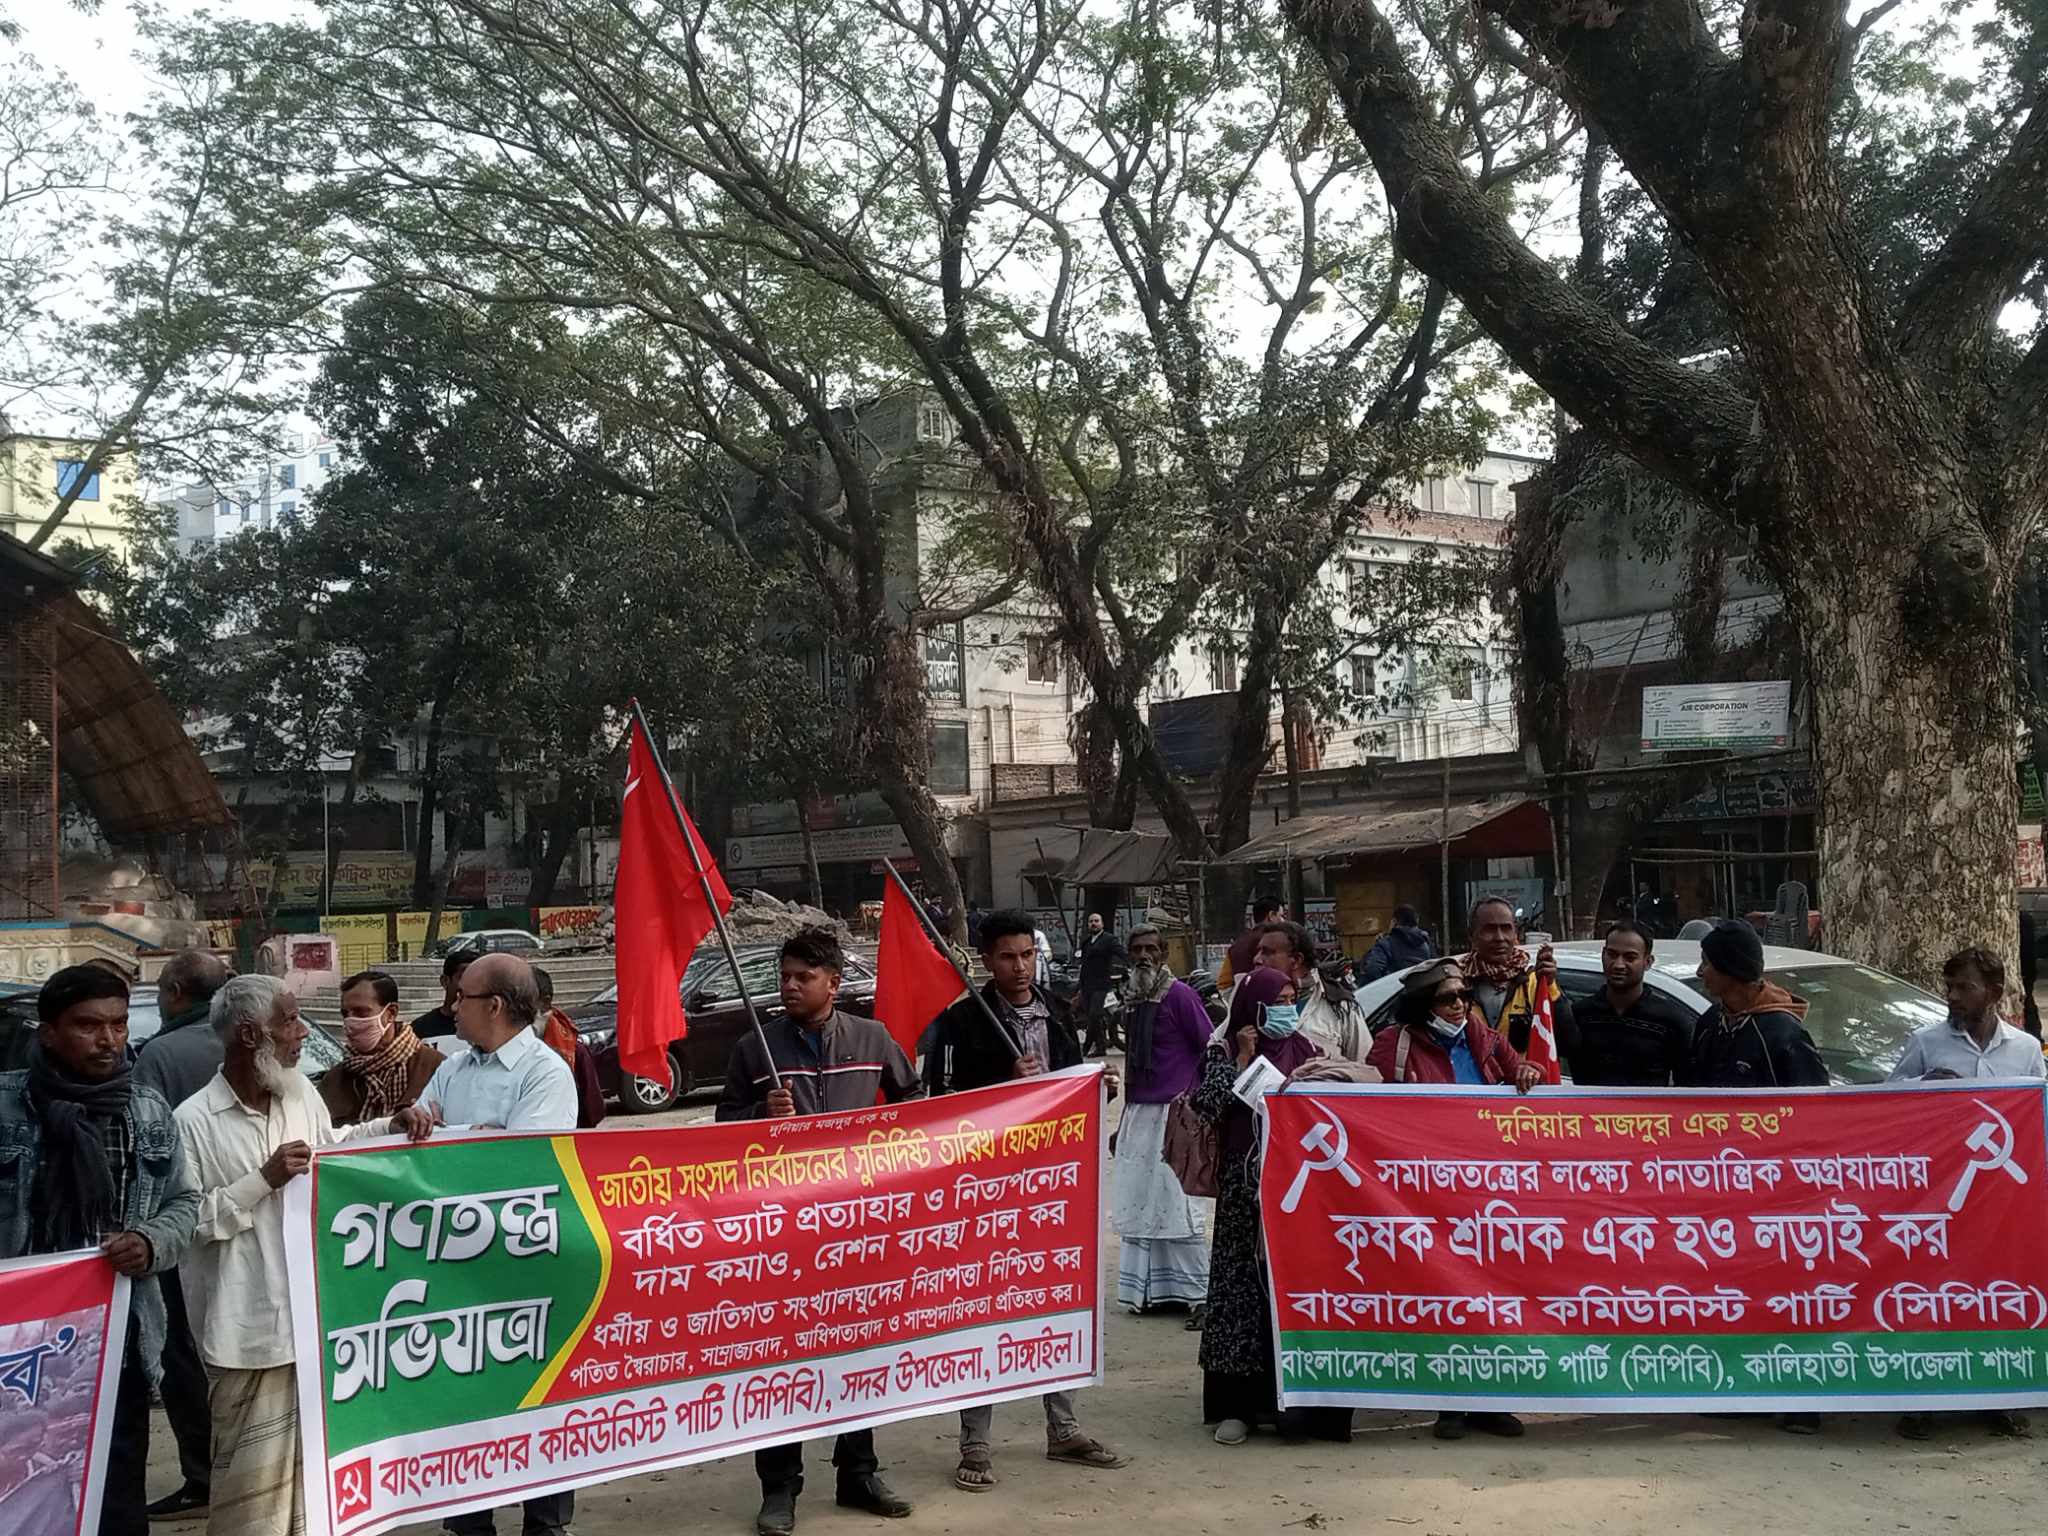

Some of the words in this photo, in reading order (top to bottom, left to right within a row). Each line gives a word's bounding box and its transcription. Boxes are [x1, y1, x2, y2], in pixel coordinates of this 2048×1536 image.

[1680, 703, 1693, 712] AIR
[1694, 701, 1749, 712] CORPORATION
[597, 1156, 672, 1209] জাতীয়
[677, 1159, 738, 1202] সংসদ
[743, 1143, 847, 1191] নির্বাচনের
[851, 1127, 931, 1188] সুনির্দিষ্ট
[934, 1120, 995, 1166] তারিখ
[1002, 1119, 1058, 1156] ঘোষণা
[1060, 1112, 1087, 1144] কর
[1374, 1156, 1543, 1193] সমাজতন্ত্রের
[1547, 1159, 1633, 1194] লক্ষ্যে
[1642, 1147, 1783, 1193] গনতান্ত্রিক
[1791, 1153, 1932, 1192] অগ্রযাত্রায়
[1477, 1106, 1584, 1144] “দুনিয়ার
[1590, 1112, 1672, 1144] মজদুর
[1683, 1112, 1730, 1138] এক
[1737, 1106, 1794, 1140] হও”
[330, 1184, 560, 1269] গণতন্ত্র
[618, 1211, 706, 1260] বর্ধিত
[712, 1201, 788, 1245] ভ্যাট
[796, 1192, 915, 1236] প্রত্যাহার
[924, 1188, 944, 1212] ও
[953, 1161, 1081, 1210] নিত্যপন্যের
[632, 1264, 696, 1296] দাম
[704, 1252, 802, 1288] কমাও,
[814, 1234, 889, 1270] রেশন
[897, 1218, 969, 1256] ব্যবস্থা
[976, 1208, 1024, 1240] চালু
[1028, 1200, 1069, 1228] কর
[1329, 1215, 1438, 1285] কৃষক
[1446, 1199, 1568, 1266] শ্রমিক
[1583, 1216, 1658, 1264] এক
[1667, 1215, 1737, 1271] হও
[1748, 1199, 1872, 1271] লড়াই
[1879, 1212, 1953, 1260] কর
[327, 1279, 554, 1402] অভিযাত্রা
[570, 1358, 621, 1389] পতিত
[623, 1351, 694, 1380] স্বৈরাচার,
[794, 1318, 883, 1351] আধিপত্যবাদ
[888, 1315, 900, 1333] ও
[904, 1296, 992, 1330] সাম্প্রদায়িকতা
[995, 1284, 1047, 1312] প্রতিহত
[593, 1312, 652, 1349] ধর্মীয়
[659, 1317, 678, 1338] ও
[687, 1300, 779, 1336] জাতিগত
[783, 1278, 907, 1321] সংখ্যালঘুদের
[910, 1261, 984, 1298] নিরাপত্তা
[987, 1247, 1047, 1283] নিশ্চিত
[1051, 1246, 1083, 1272] কর
[1287, 1289, 1528, 1327] বাংলাদেশের
[1536, 1284, 1752, 1327] কমিউনিস্ট
[1767, 1282, 1859, 1327] পার্টি
[1873, 1280, 2048, 1332] (সিপিবি)
[1281, 1347, 1417, 1382] বাংলাদেশের
[1425, 1343, 1550, 1383] কমিউনিস্ট
[1558, 1343, 1612, 1383] পার্টি
[1621, 1343, 1735, 1391] (সিপিবি),
[1741, 1341, 1860, 1385] কালিহাতী
[1864, 1341, 1974, 1381] উপজেলা
[379, 1433, 532, 1497] বাংলাদেশের
[539, 1396, 669, 1464] কমিউনিস্ট
[675, 1382, 727, 1436] পার্টি
[733, 1367, 832, 1435] (সিপিবি),
[840, 1365, 890, 1403] সদর
[896, 1347, 991, 1392] উপজেলা,
